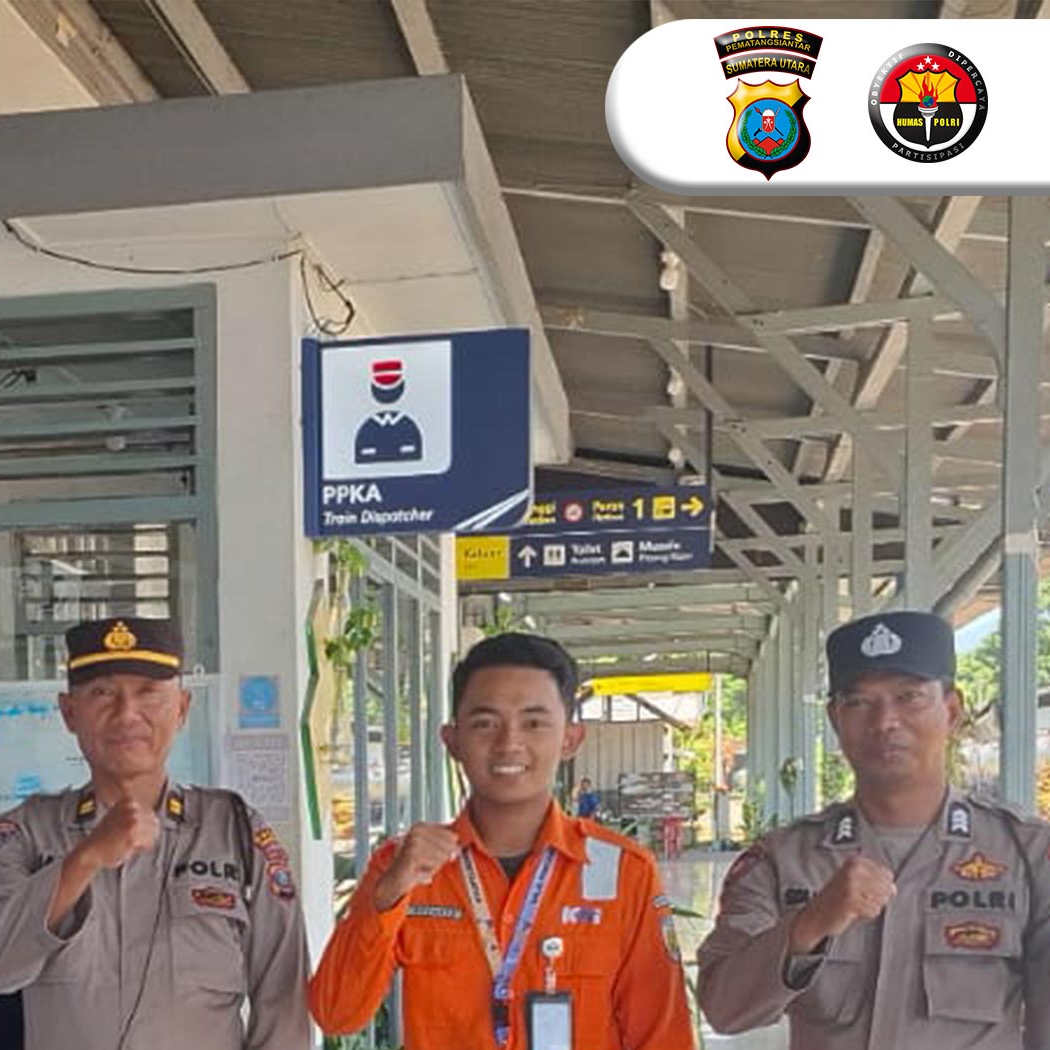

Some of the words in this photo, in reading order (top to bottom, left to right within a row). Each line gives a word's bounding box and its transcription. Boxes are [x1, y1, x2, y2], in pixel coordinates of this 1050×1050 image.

[322, 483, 383, 505] PPKA
[323, 511, 358, 525] Train
[360, 508, 434, 526] Dispatcher
[931, 890, 1016, 910] POLRI
